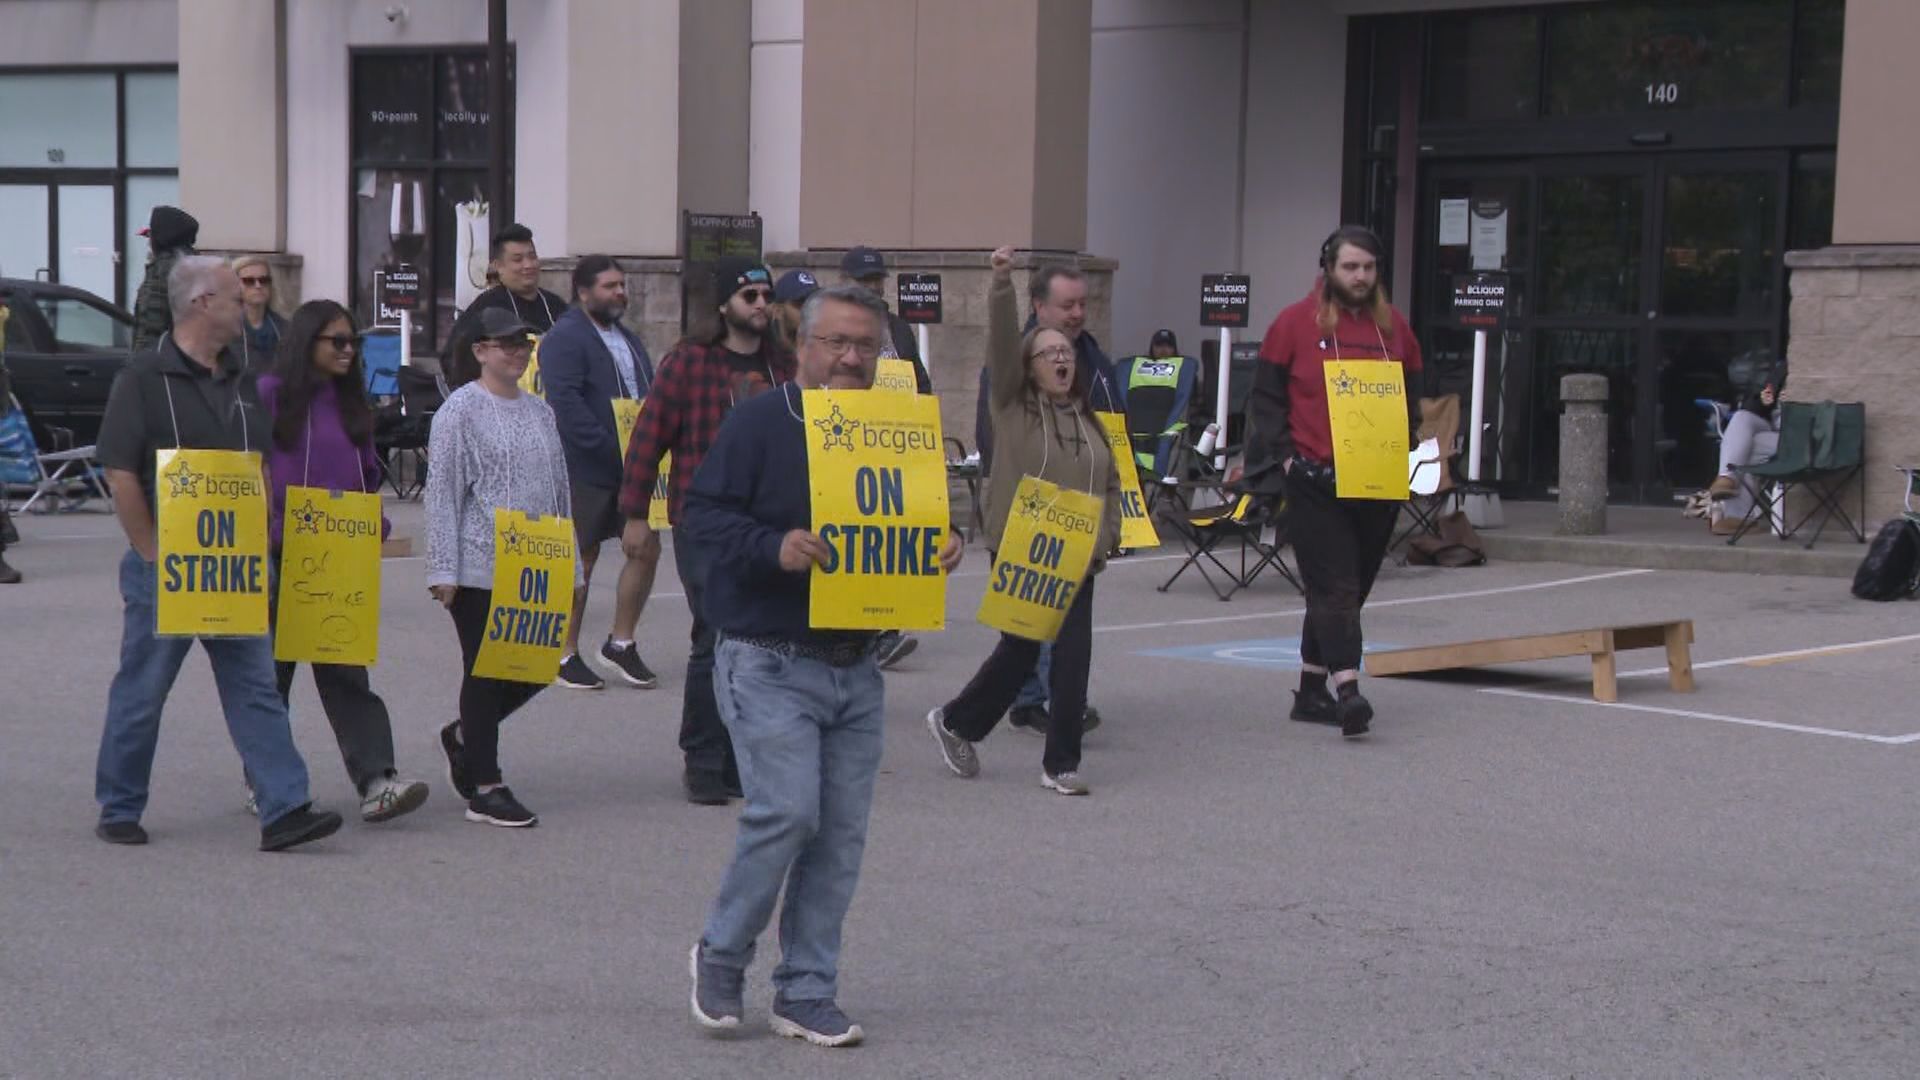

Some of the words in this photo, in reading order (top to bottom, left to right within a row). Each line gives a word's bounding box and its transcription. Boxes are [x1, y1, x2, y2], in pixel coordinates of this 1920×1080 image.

[1646, 83, 1678, 103] 140
[480, 112, 489, 125] y
[1454, 298, 1484, 306] PARKING
[1359, 379, 1402, 399] bcgeu
[863, 423, 937, 454] bcgeu
[205, 476, 261, 499] bcgeu
[855, 465, 904, 516] ON
[197, 508, 235, 548] ON
[325, 513, 377, 538] bcgeu
[1046, 508, 1096, 535] bcgeu
[527, 536, 571, 560] bcgeu
[819, 523, 942, 576] STRIKE
[1028, 532, 1065, 570] ON
[164, 553, 262, 594] STRIKE
[519, 567, 549, 604] ON
[992, 561, 1077, 611] STRIKE
[489, 606, 567, 648] STRIKE
